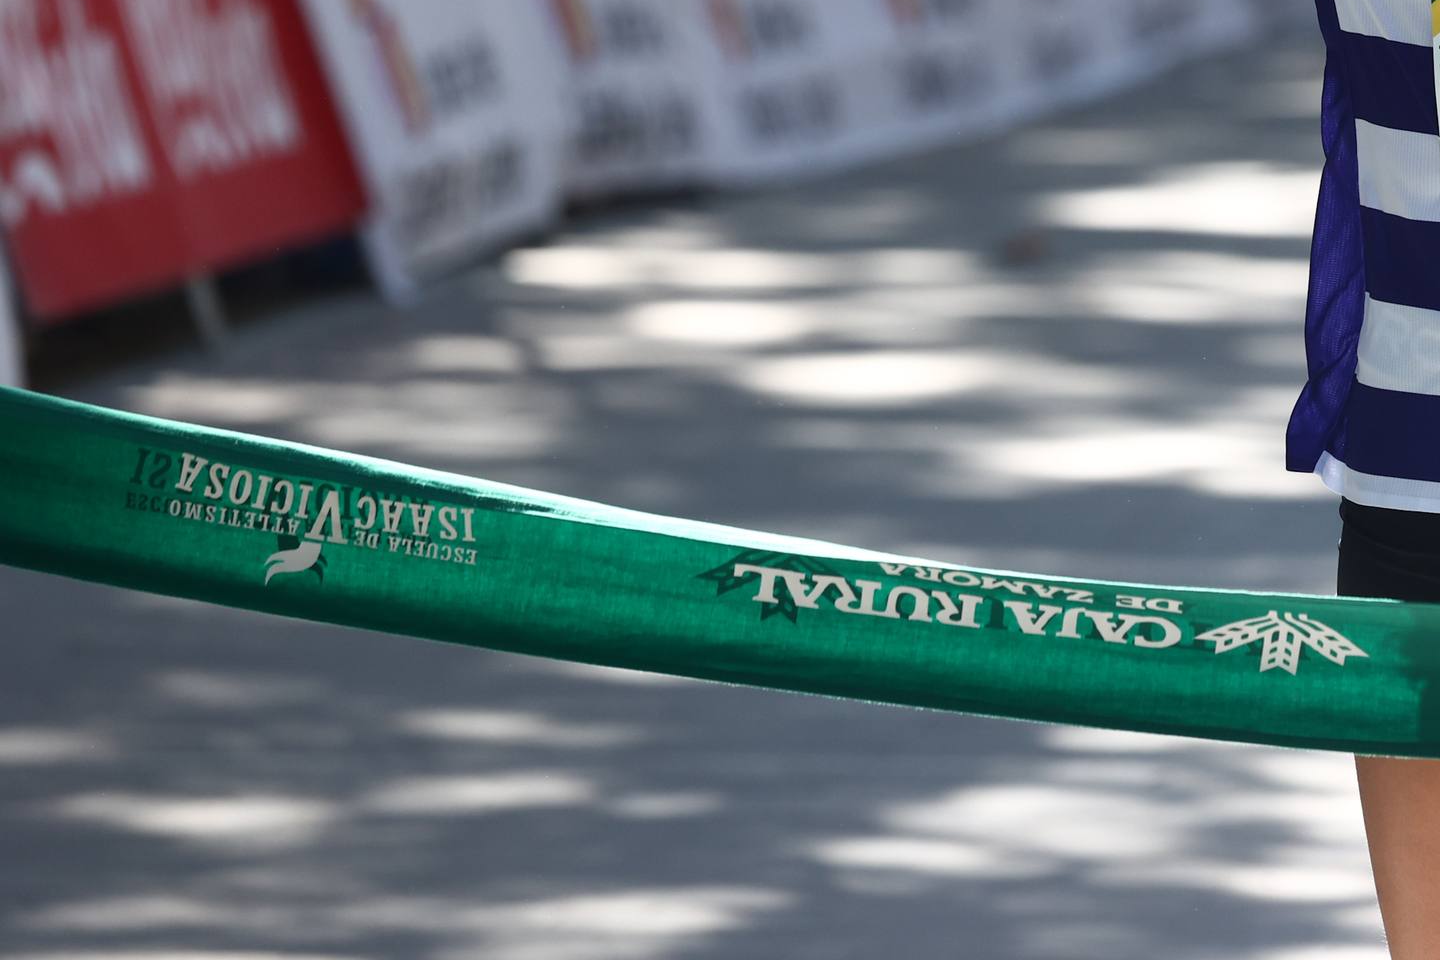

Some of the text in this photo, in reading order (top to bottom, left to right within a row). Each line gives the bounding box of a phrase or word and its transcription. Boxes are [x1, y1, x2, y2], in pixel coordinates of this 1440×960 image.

[169, 499, 300, 536] ATLETISMO
[354, 530, 379, 549] DE
[389, 535, 477, 565] ESCUELA
[733, 563, 1181, 648] CAJA RURAL
[879, 562, 1183, 614] DE ZAMORA
